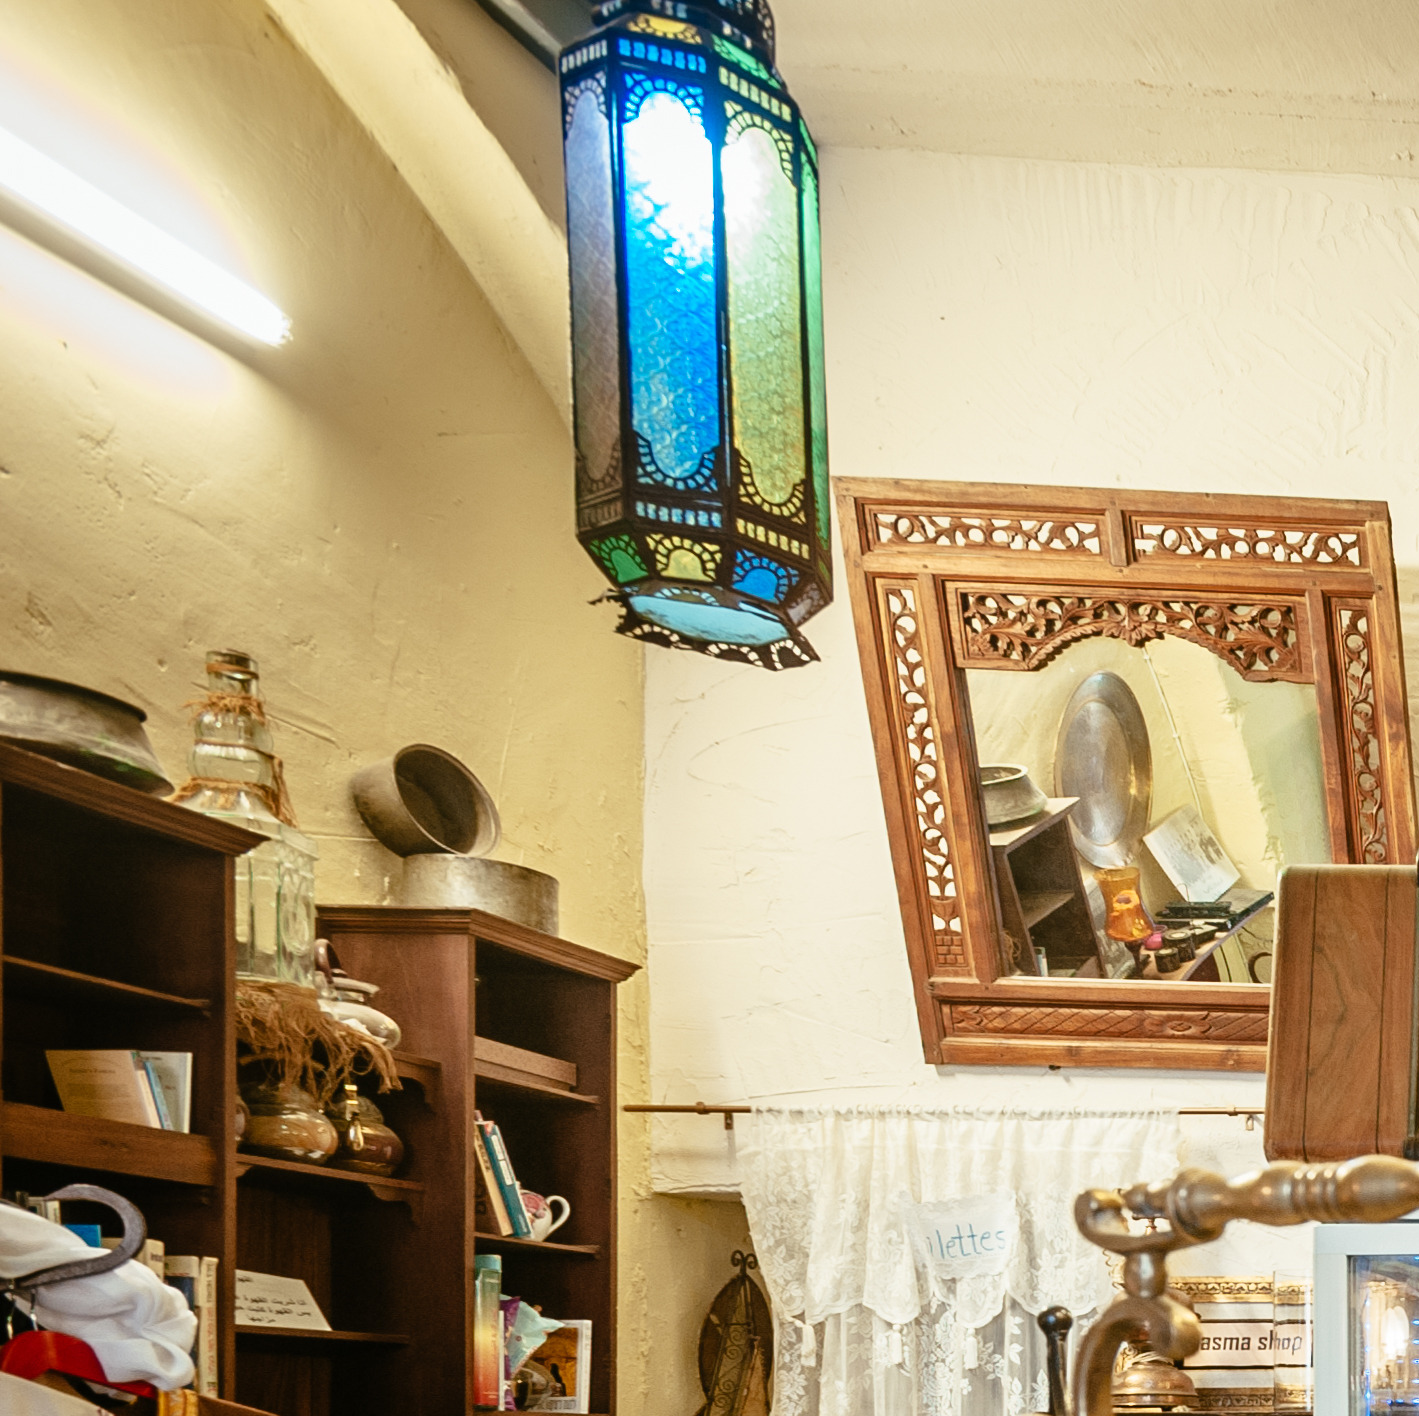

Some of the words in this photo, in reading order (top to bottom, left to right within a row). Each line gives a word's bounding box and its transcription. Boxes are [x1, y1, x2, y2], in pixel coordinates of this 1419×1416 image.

[926, 1223, 1005, 1259] ilettes
[1200, 1336, 1251, 1350] asma
[1258, 1329, 1303, 1356] shop
